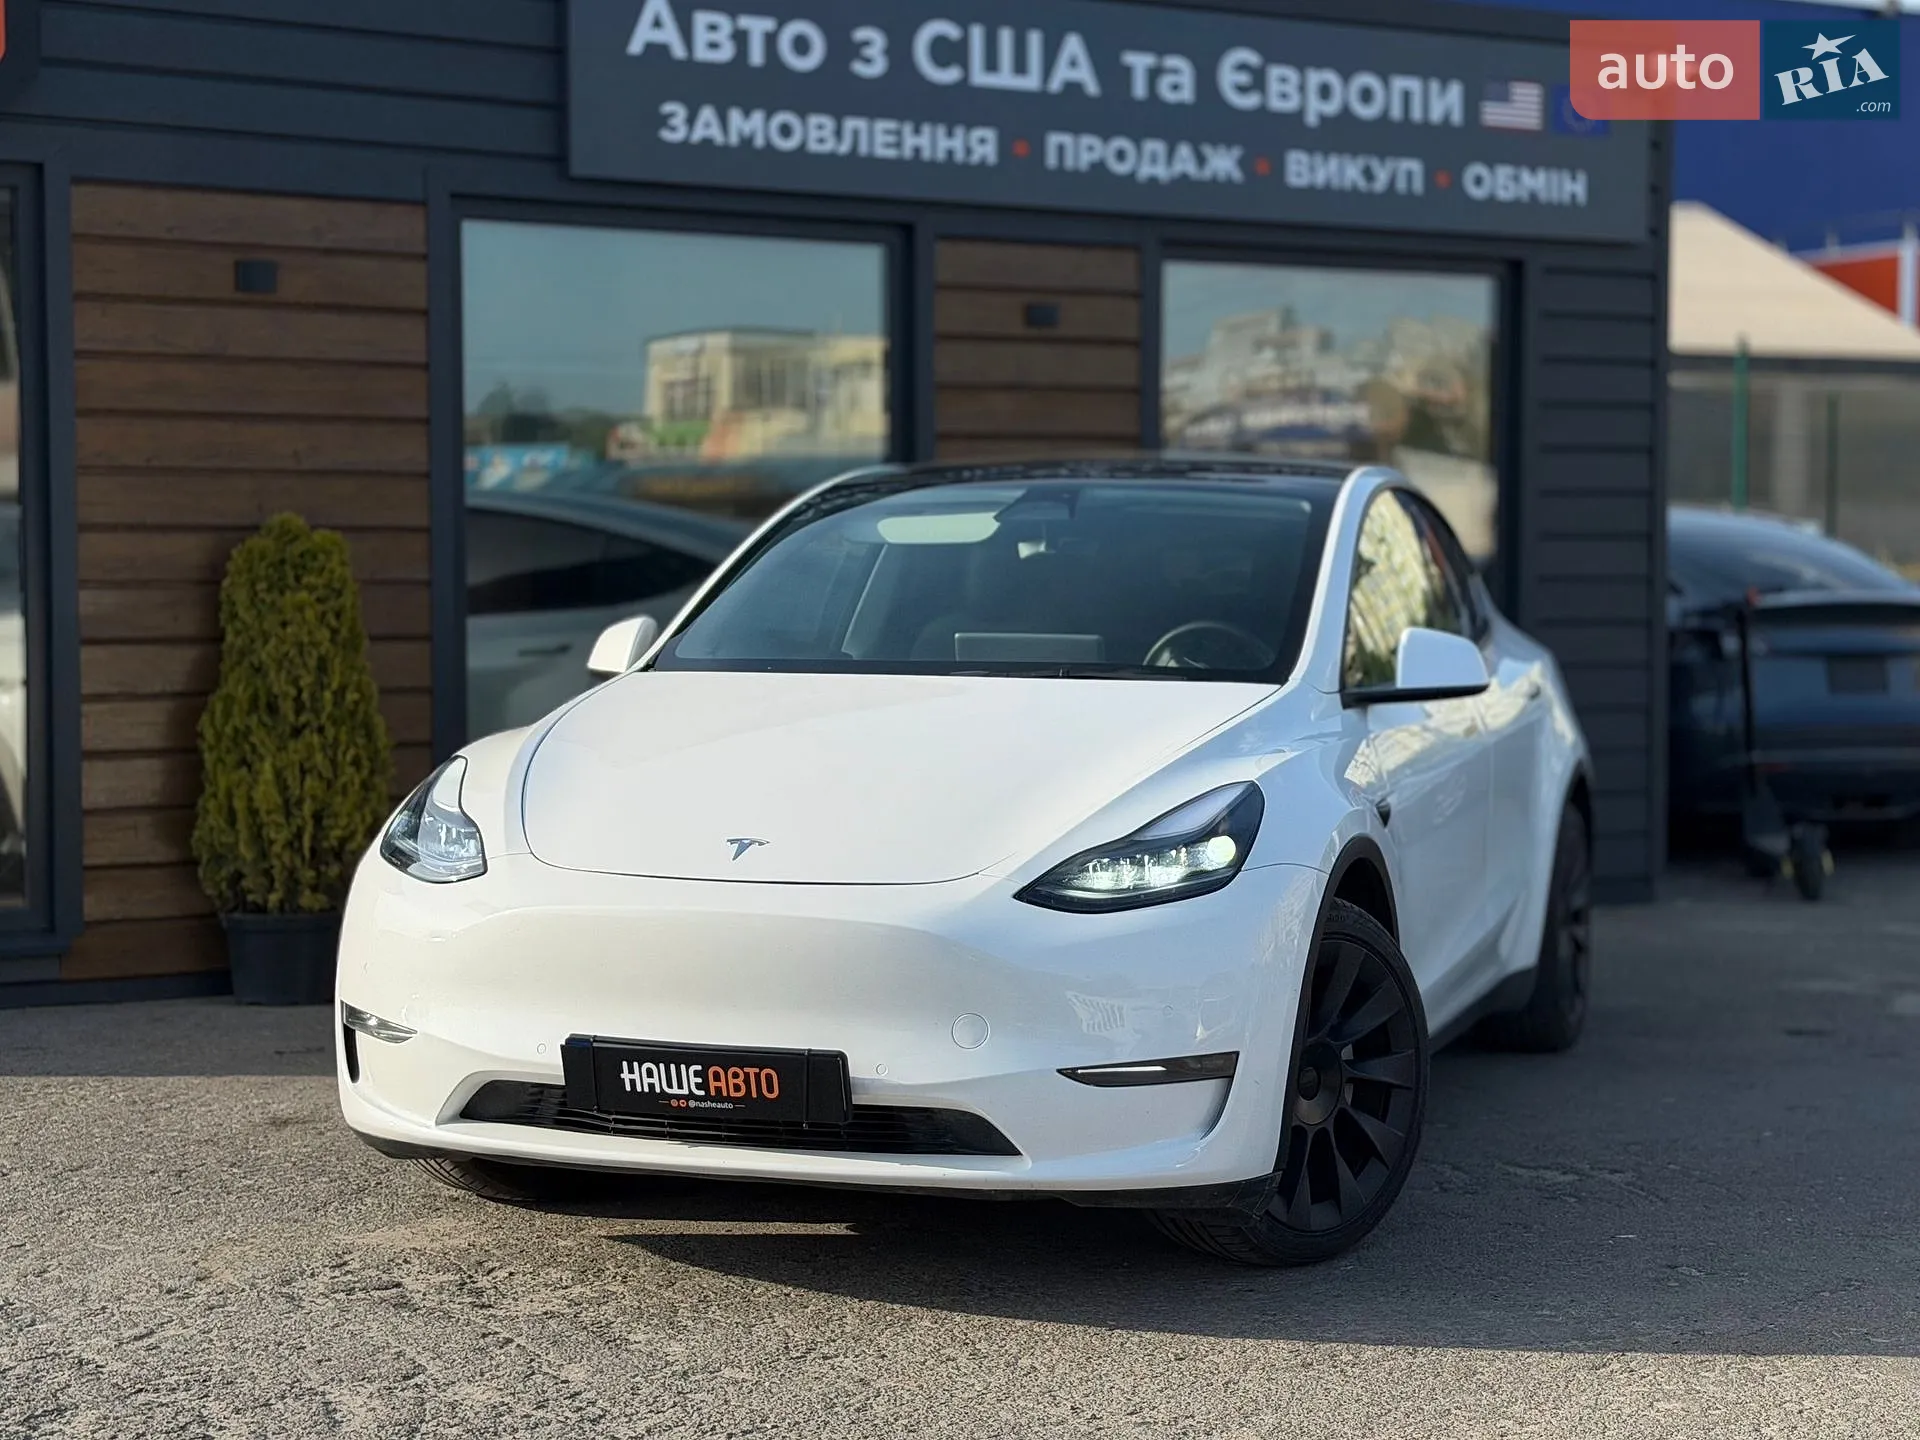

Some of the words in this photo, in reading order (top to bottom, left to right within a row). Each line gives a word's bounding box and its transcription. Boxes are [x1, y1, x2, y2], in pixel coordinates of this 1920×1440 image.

[626, 0, 827, 72] Авто
[912, 18, 1101, 97] США
[1120, 49, 1197, 104] та
[1216, 46, 1466, 128] Європи
[658, 101, 998, 166] ЗАМОВЛЕННЯ
[1045, 131, 1244, 183] ПРОДАЖ
[1285, 149, 1424, 195] ВИКУП
[1463, 161, 1588, 206] ОБМІН
[620, 1060, 706, 1096] НАШЕ
[707, 1065, 780, 1099] АВТО
[688, 1099, 734, 1109] @nasheauto
